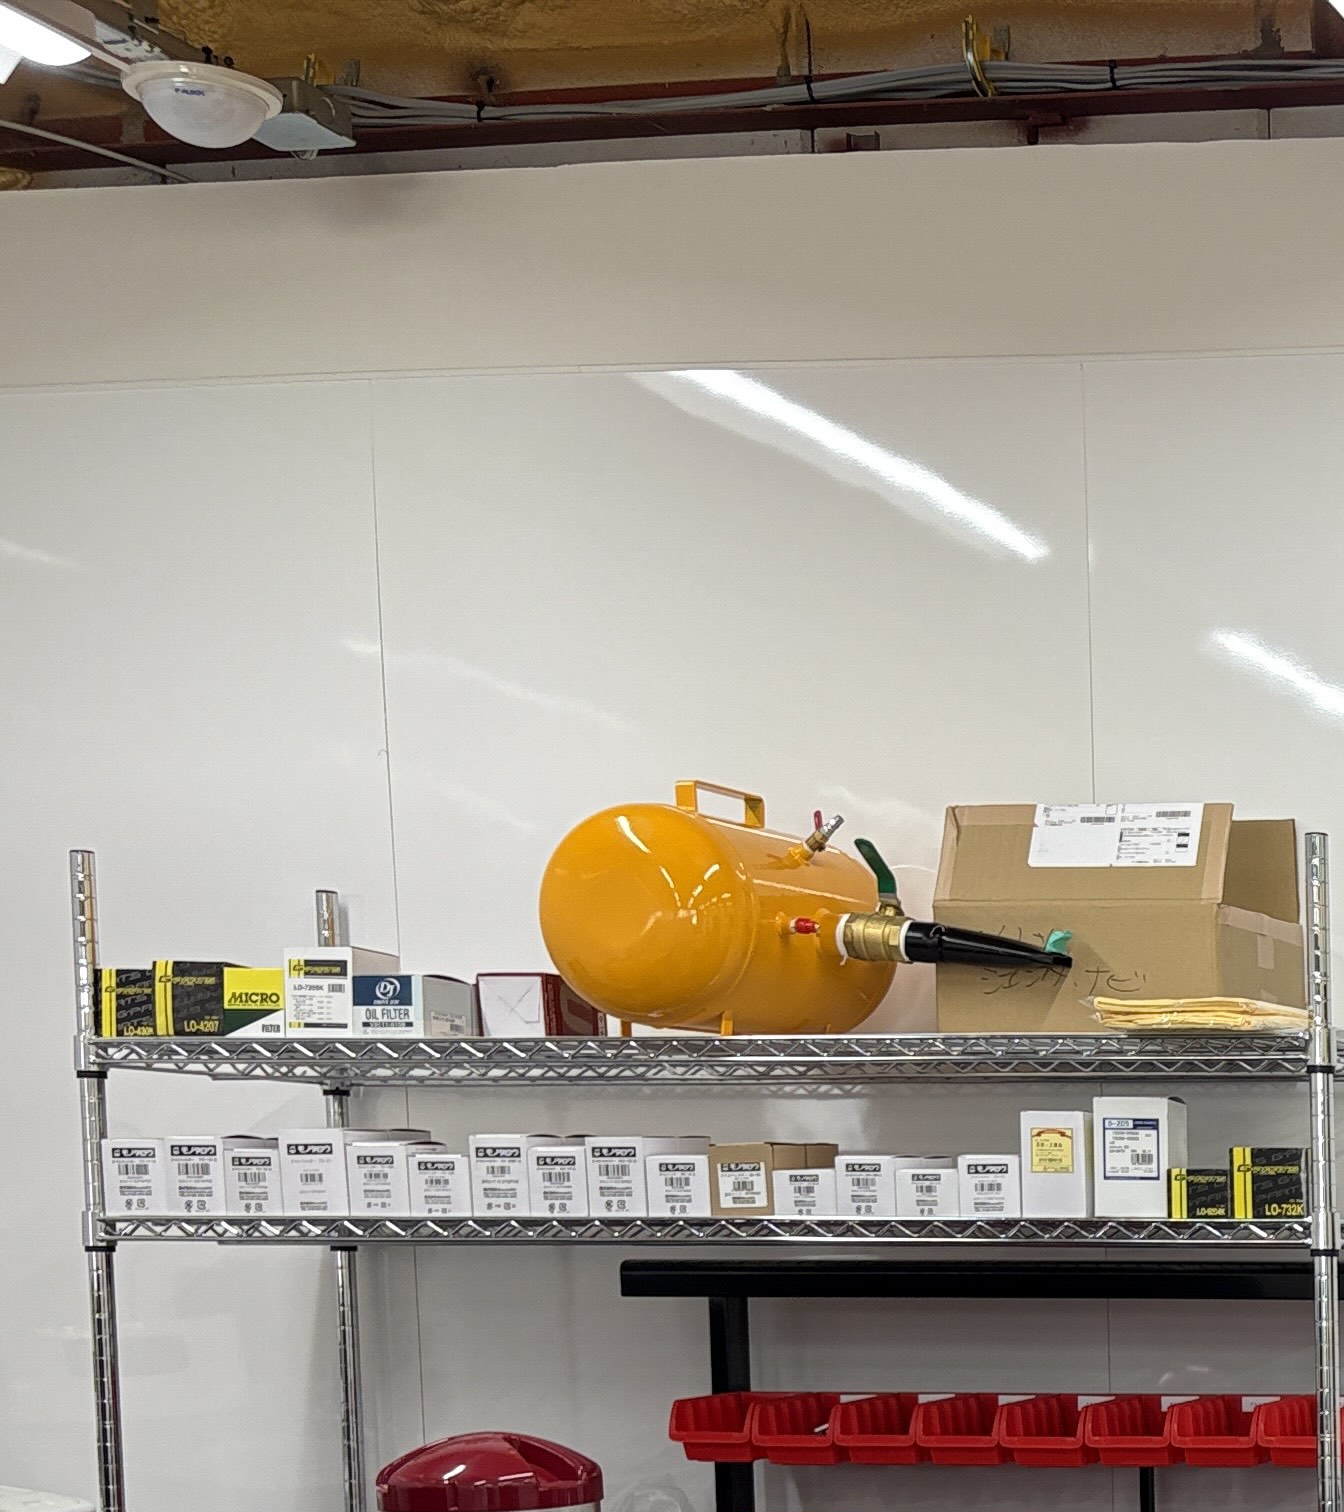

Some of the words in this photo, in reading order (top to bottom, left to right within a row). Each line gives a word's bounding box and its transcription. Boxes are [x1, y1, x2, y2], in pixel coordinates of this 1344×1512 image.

[228, 992, 280, 1004] MICRO
[365, 1008, 379, 1020] OIL
[381, 1008, 410, 1020] FILTER
[1265, 1204, 1304, 1216] LO-732K
